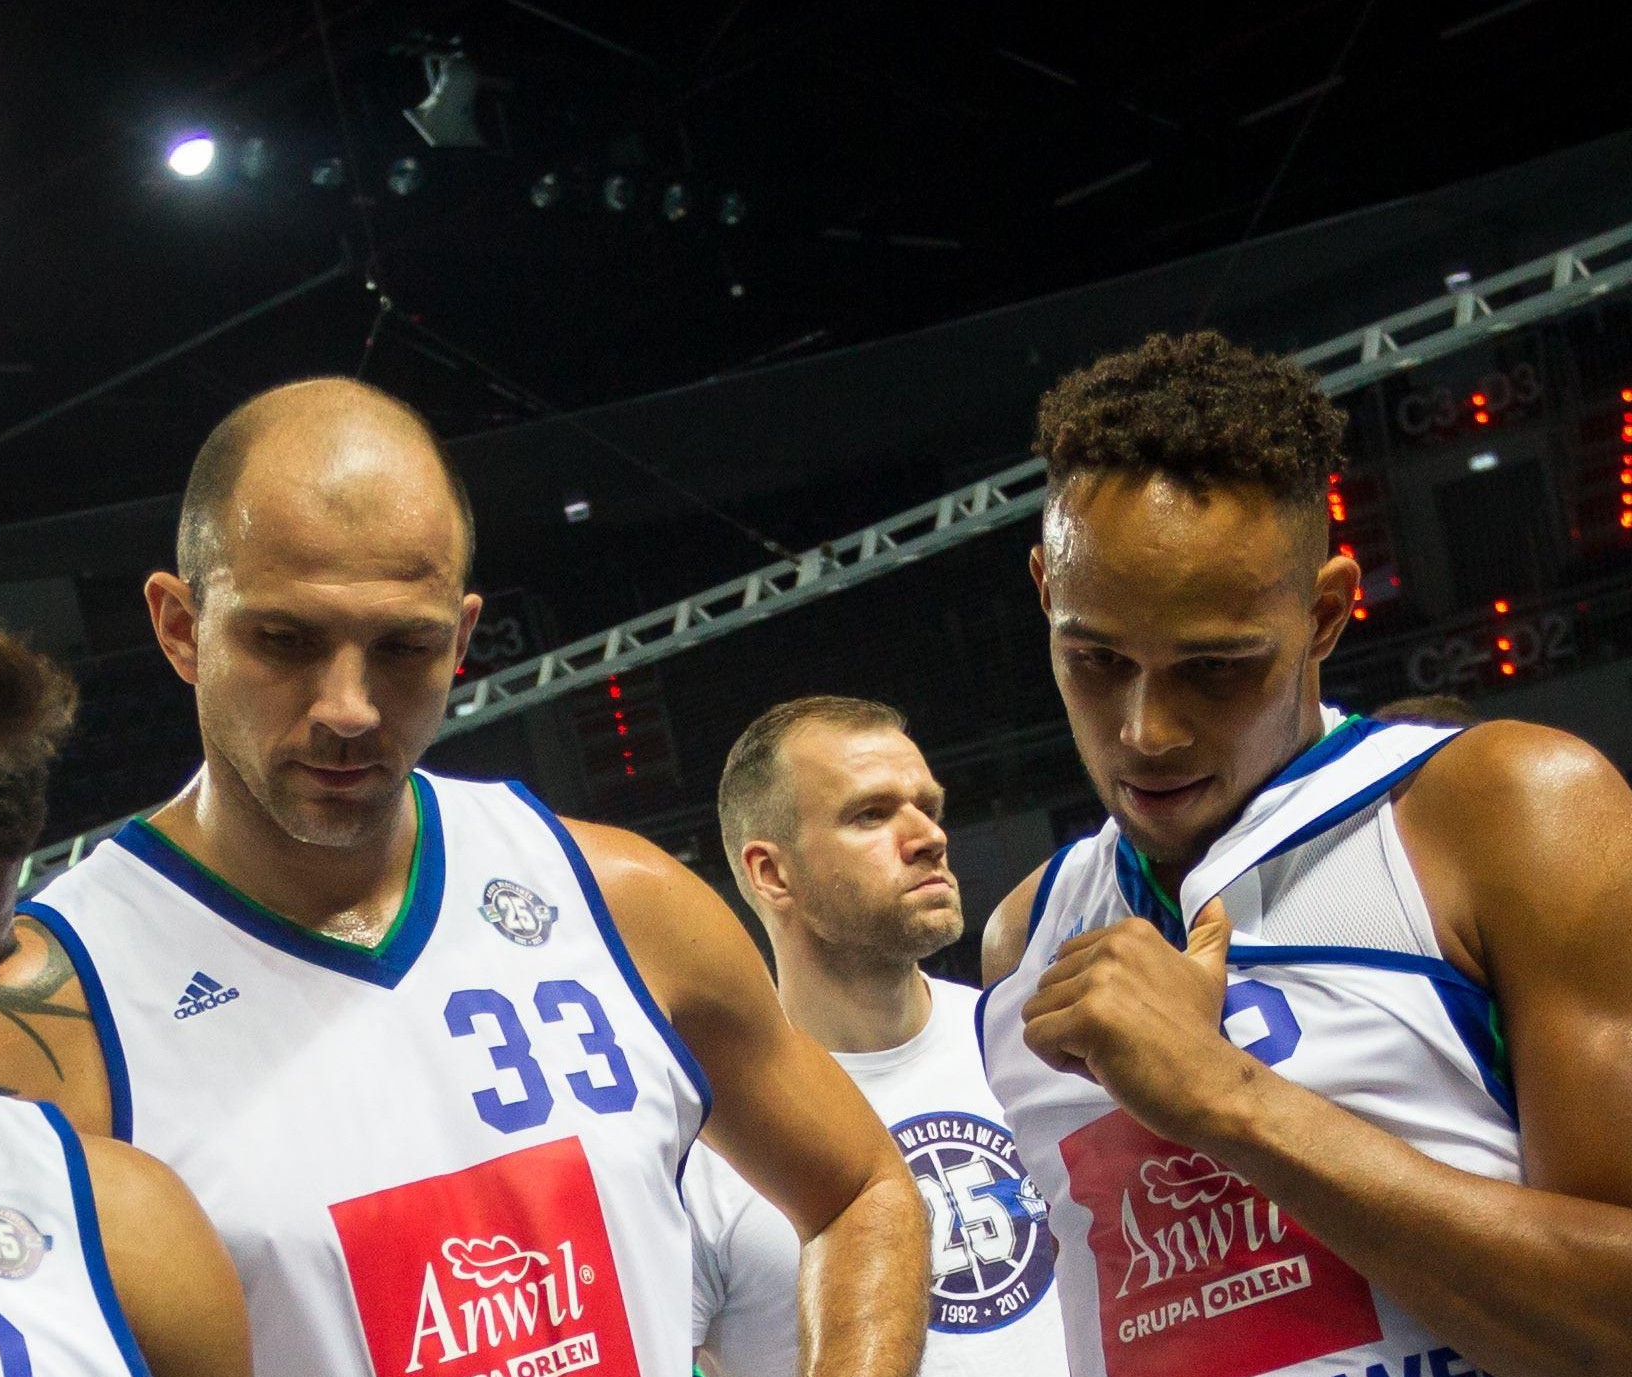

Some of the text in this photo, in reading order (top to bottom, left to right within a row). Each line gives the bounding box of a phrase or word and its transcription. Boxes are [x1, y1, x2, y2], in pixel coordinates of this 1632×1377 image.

[497, 895, 537, 931] 25
[174, 987, 240, 1020] adidas
[443, 979, 639, 1135] 33
[897, 1120, 1017, 1160] WŁOCŁAWEK
[916, 1157, 1017, 1280] 25
[405, 1240, 584, 1374] Anwil
[940, 1281, 1031, 1323] 1992 2017
[1118, 1262, 1303, 1343] GRUPA ORLEN
